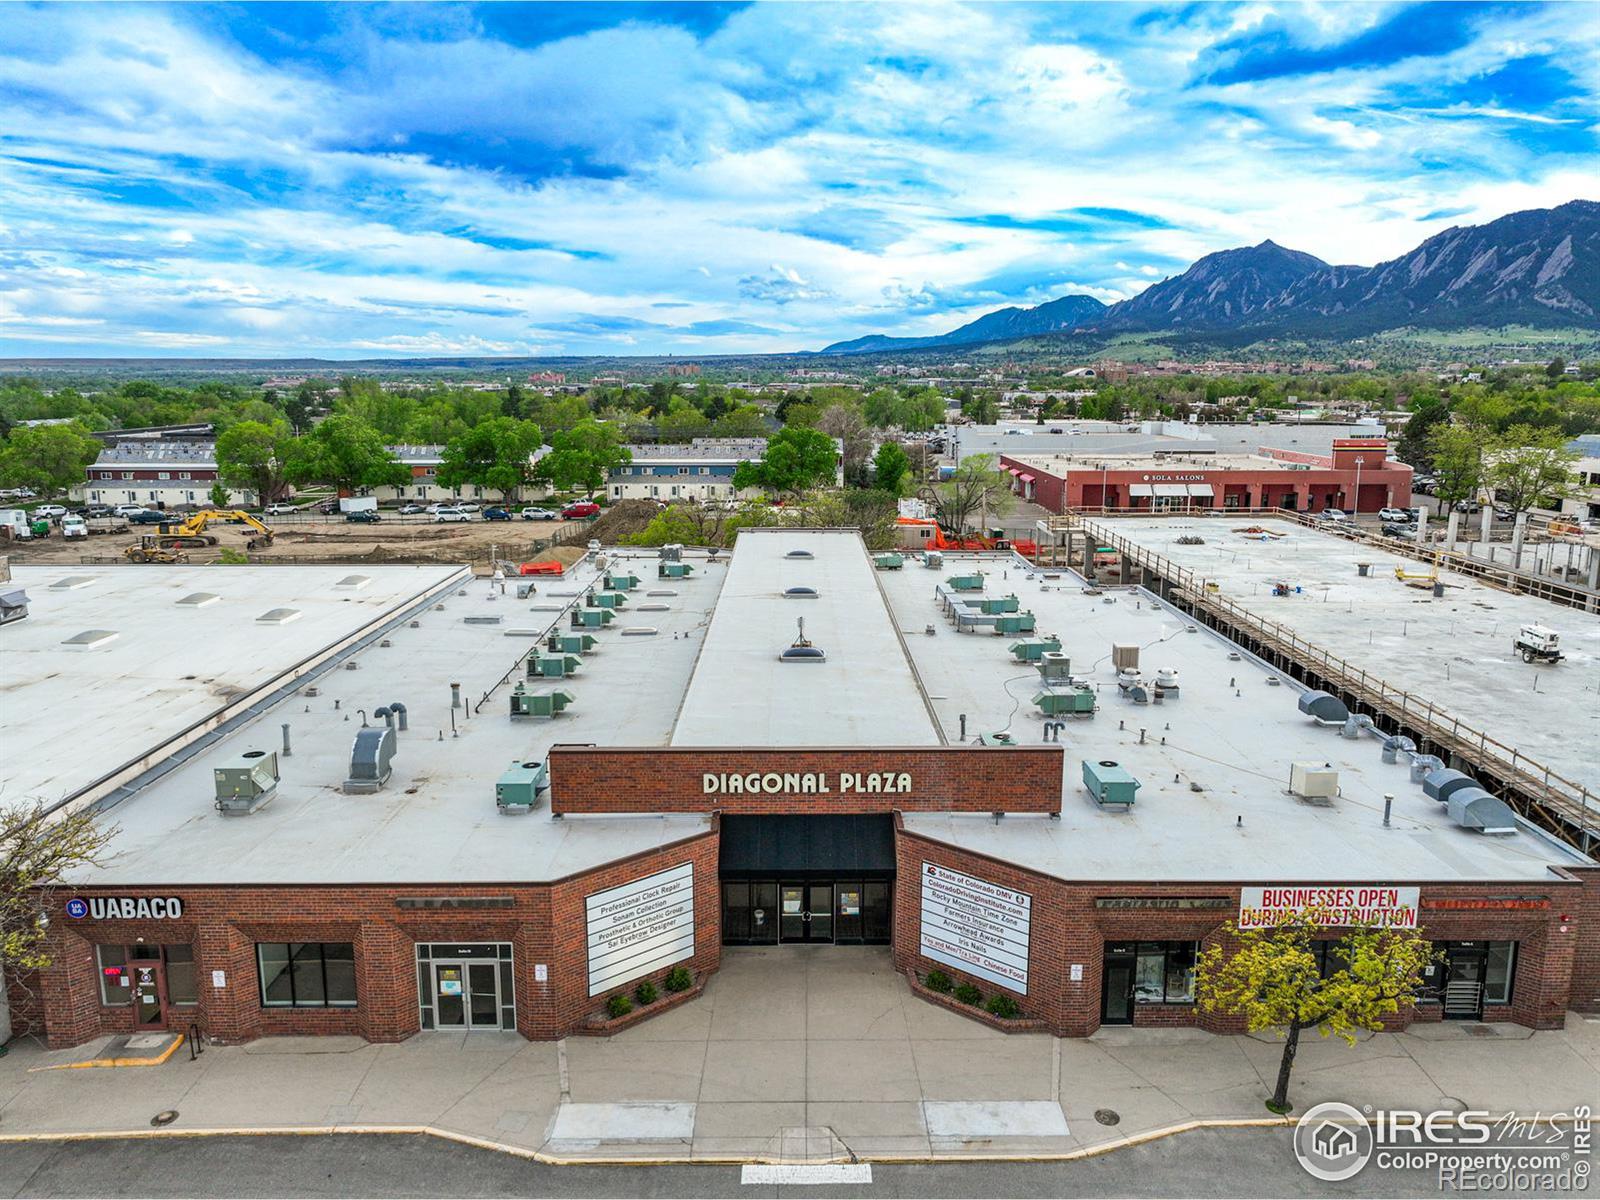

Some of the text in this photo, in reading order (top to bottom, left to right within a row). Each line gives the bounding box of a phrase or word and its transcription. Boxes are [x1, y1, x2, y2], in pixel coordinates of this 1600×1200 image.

[703, 773, 912, 794] DIAGONAL PLAZA
[938, 870, 1013, 900] State of Colorado DMV
[90, 898, 182, 919] UABACO
[600, 882, 680, 914] Professional Clock Repair
[932, 890, 1018, 926] Rocky Mountain Time Zone
[1262, 890, 1398, 908] BUSINESSES OPEN
[599, 924, 631, 941] Prosthetic
[638, 914, 664, 926] Orthotic
[664, 906, 684, 917] Group
[612, 900, 667, 924] Sonam Collection
[944, 908, 1004, 934] Farmers Insurance
[1301, 909, 1416, 926] ONSTRUCTION
[620, 930, 648, 944] Eyebrow
[650, 919, 676, 934] Designer
[943, 920, 1004, 946] Arrowhead Awards
[958, 938, 987, 954] Iris Nails
[983, 959, 1008, 974] Chinese
[1009, 969, 1025, 980] Food
